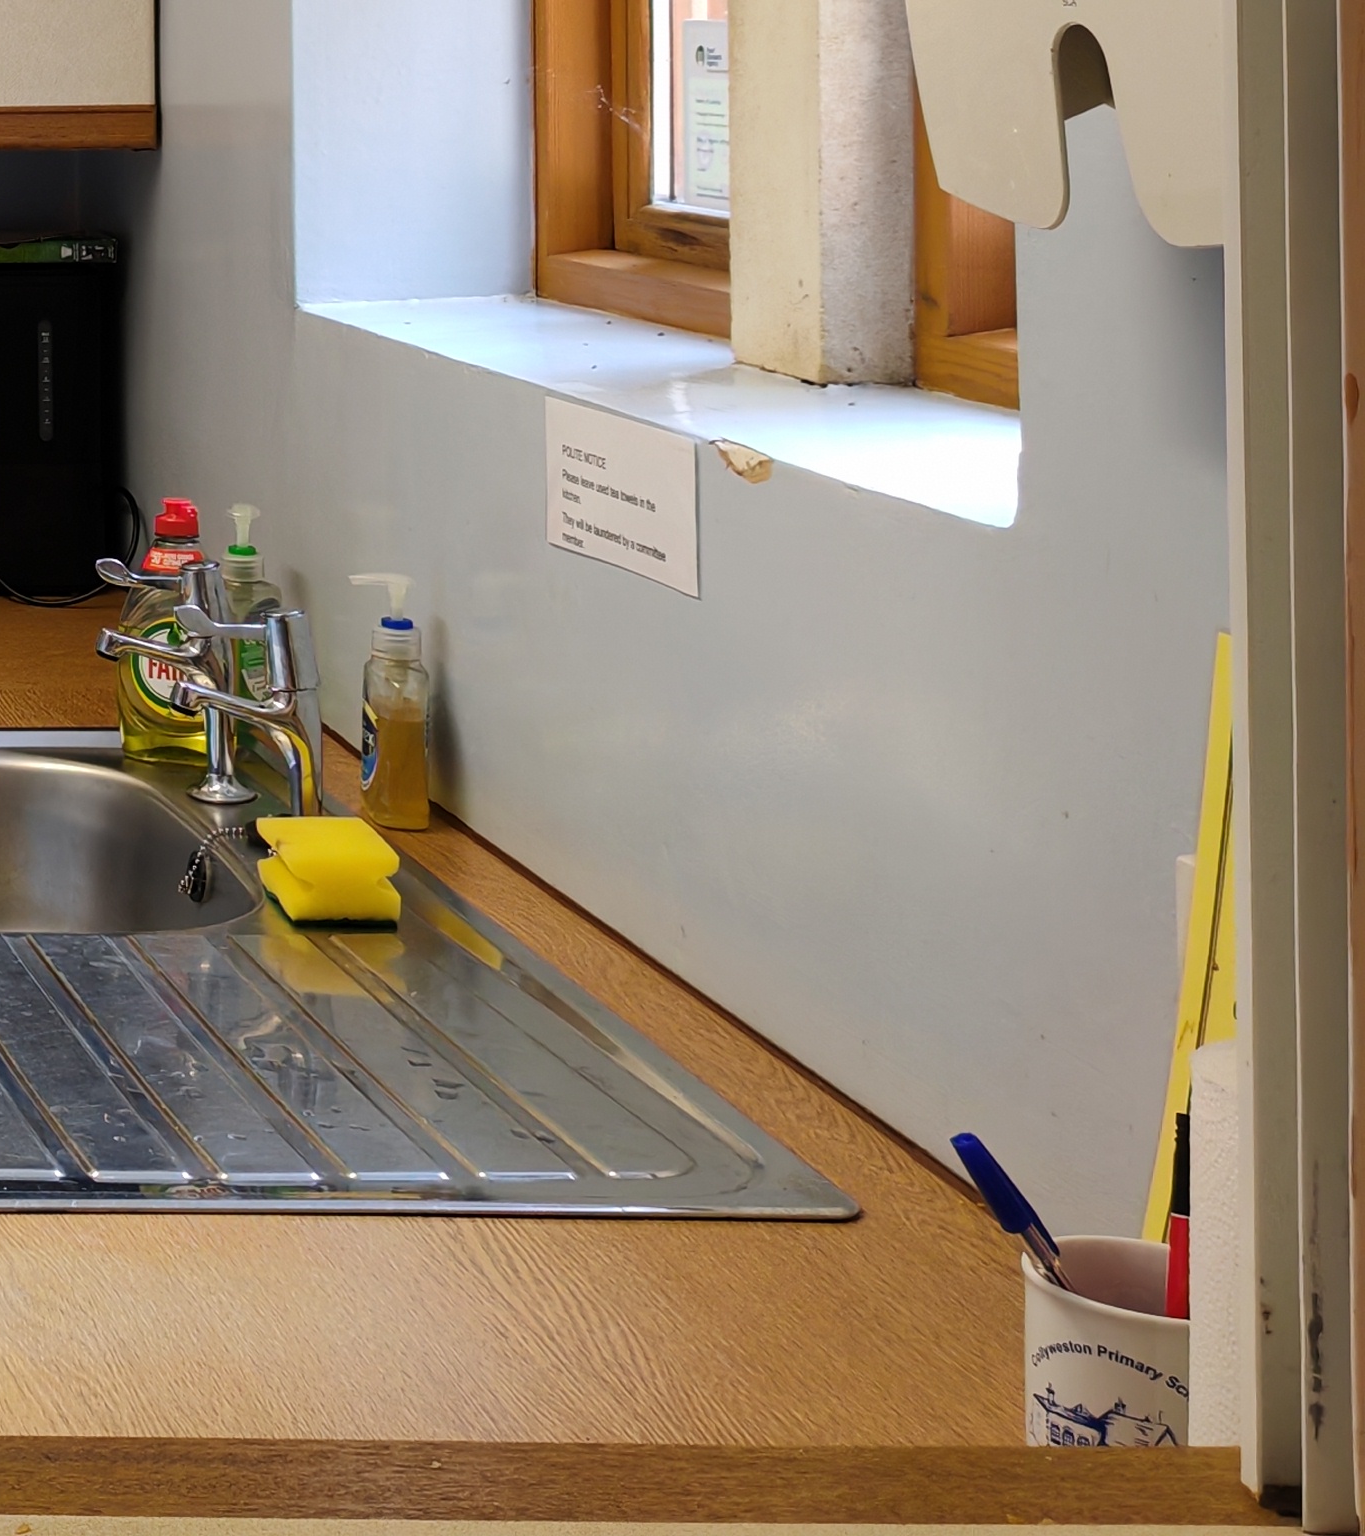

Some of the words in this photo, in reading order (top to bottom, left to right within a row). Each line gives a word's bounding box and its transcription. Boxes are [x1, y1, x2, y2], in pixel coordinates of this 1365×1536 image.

[562, 444, 583, 462] POLITE
[583, 452, 607, 470] NOTICE
[562, 468, 580, 485] Please
[580, 475, 595, 491] leave
[595, 484, 609, 496] used
[610, 486, 620, 500] tea
[620, 490, 639, 506] towels
[639, 495, 645, 508] in
[645, 499, 656, 513] the
[562, 511, 575, 529] They
[575, 519, 584, 530] will
[585, 521, 593, 534] be
[593, 523, 622, 545] laundered
[622, 536, 630, 550] by
[636, 542, 667, 563] committee
[1097, 1344, 1164, 1381] Primary
[1165, 1374, 1190, 1402] Sc
